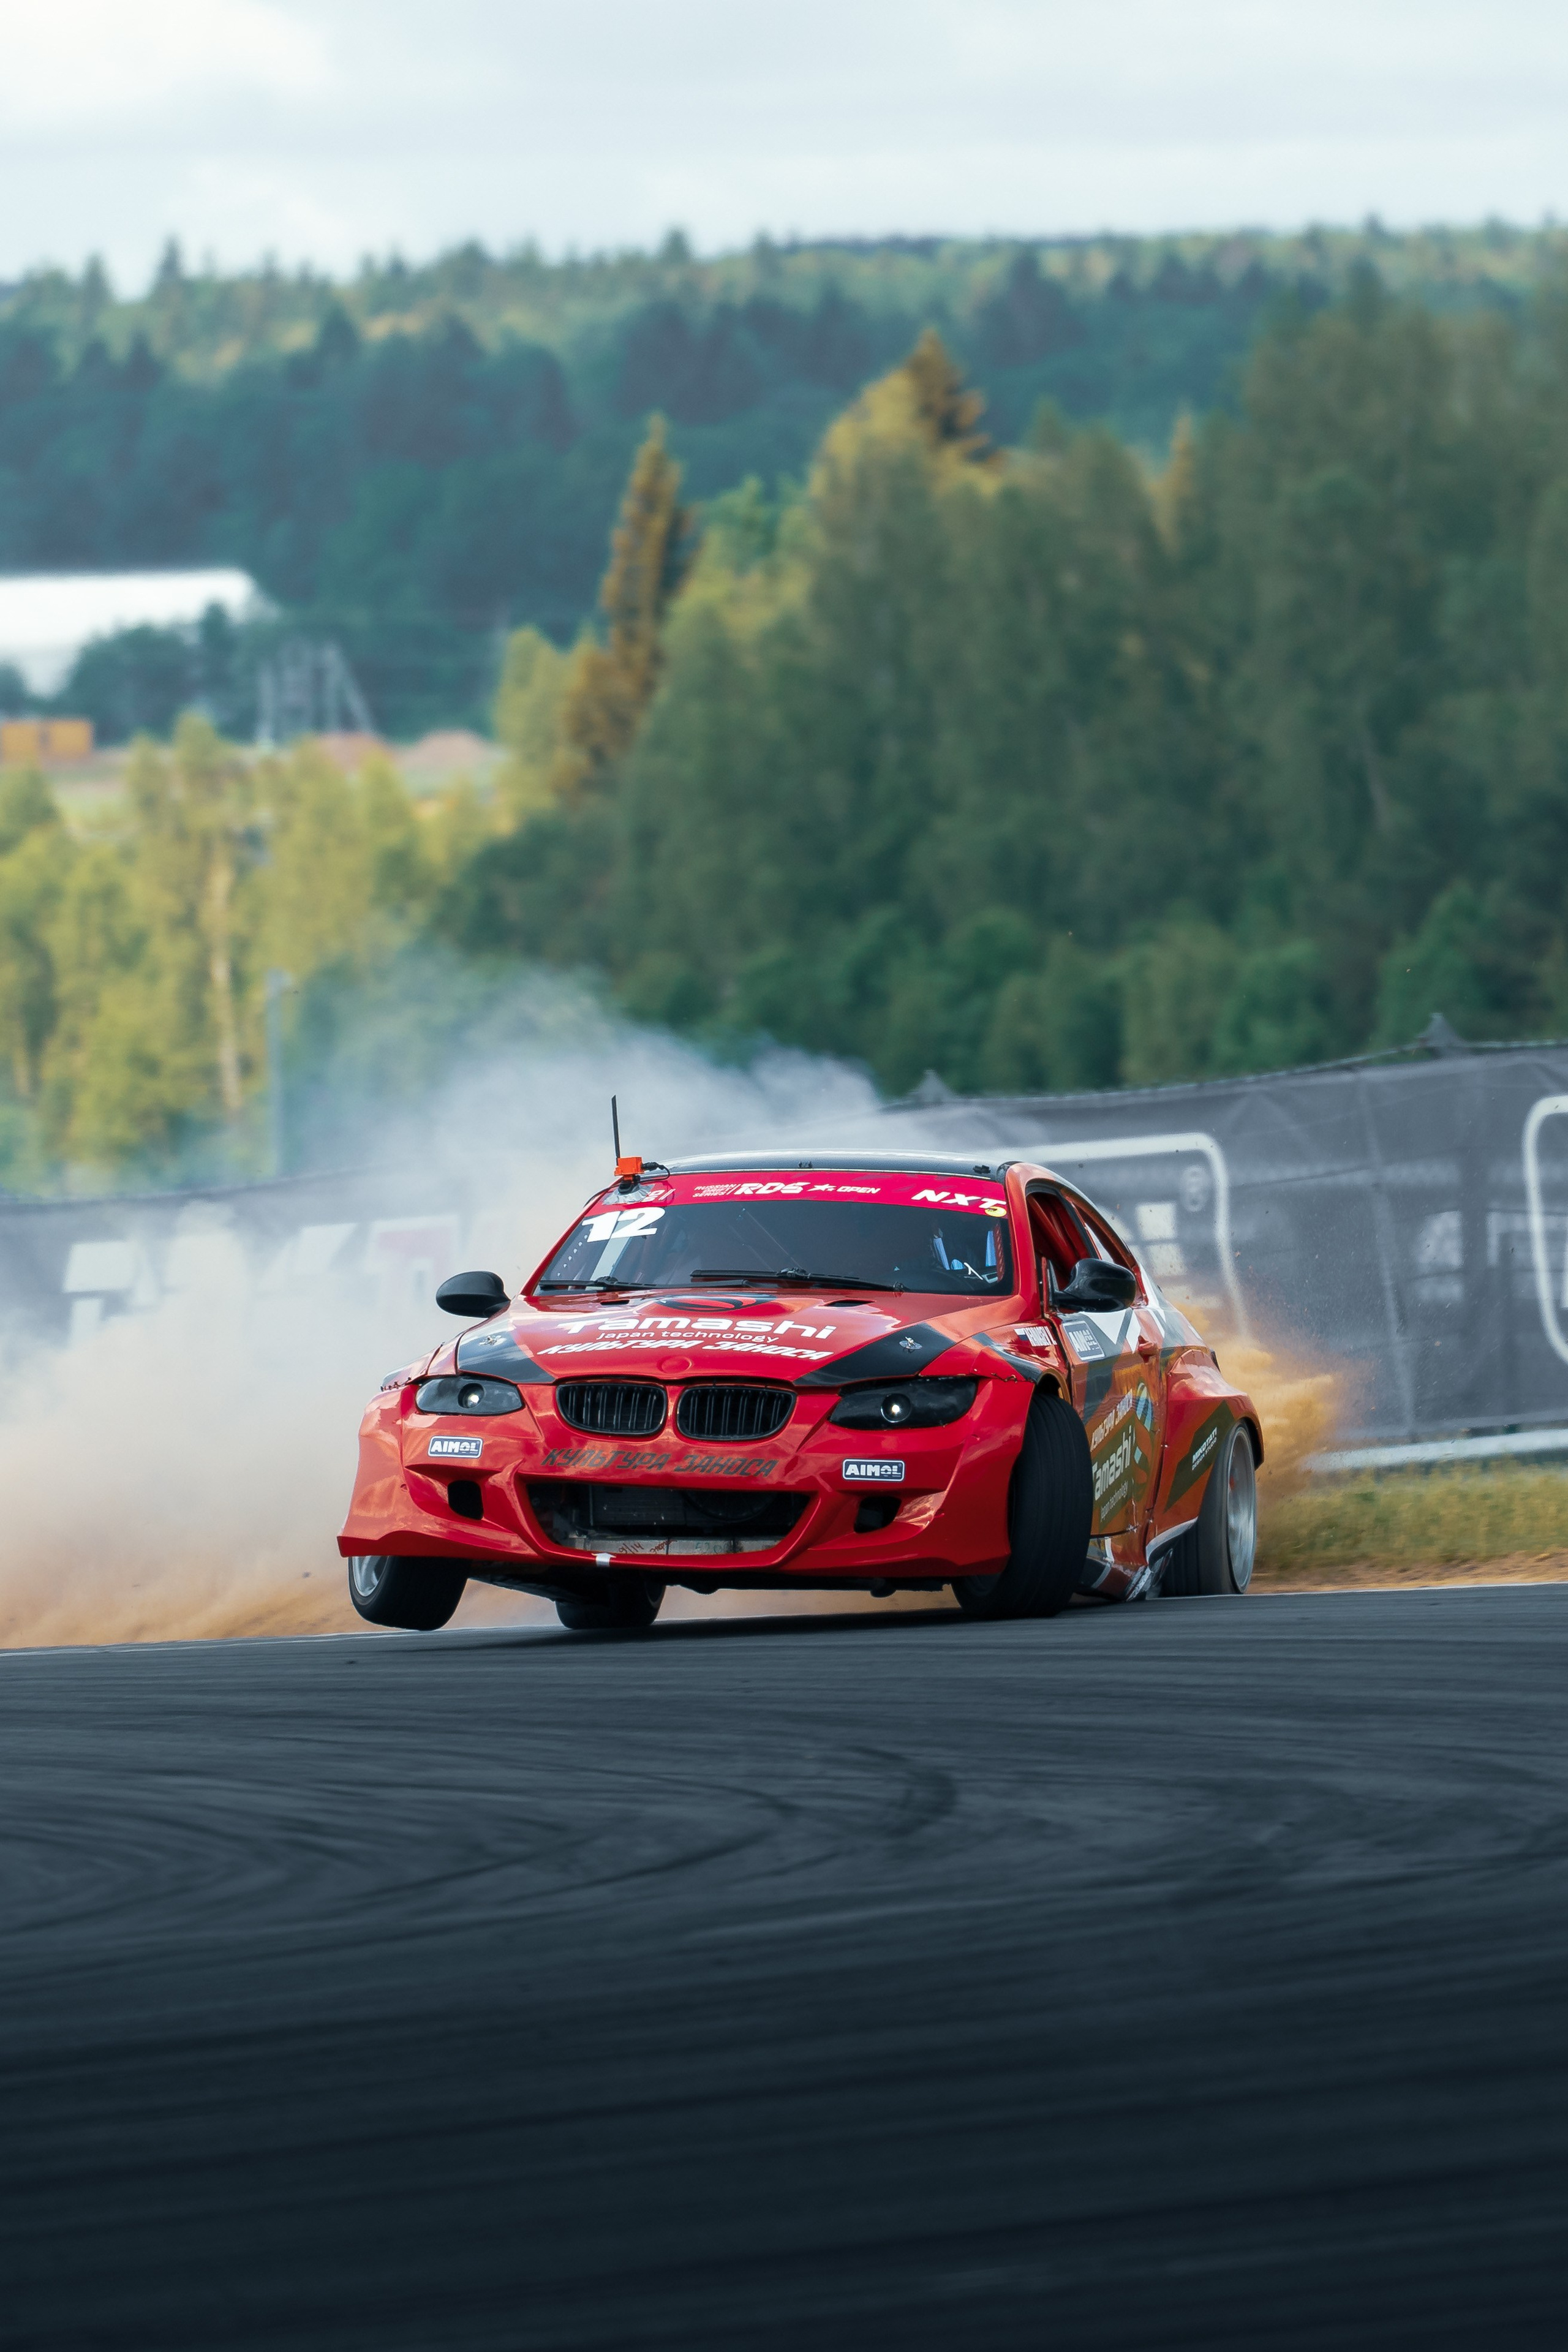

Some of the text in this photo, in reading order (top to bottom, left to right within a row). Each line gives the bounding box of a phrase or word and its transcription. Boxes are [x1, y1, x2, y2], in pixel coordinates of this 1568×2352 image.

[734, 1182, 881, 1195] RDS OPEN
[911, 1189, 1007, 1210] NXT
[581, 1207, 666, 1243] 12
[556, 1316, 837, 1340] Tamashi
[596, 1330, 780, 1343] japan technology
[537, 1340, 834, 1360] КУЛЬТУРА ЗАНОСА
[431, 1441, 478, 1454] AIMOL
[540, 1448, 780, 1477] КУЛЬТУРА ЗАНОСА
[845, 1464, 902, 1477] AIMOL
[1092, 1425, 1132, 1501] Tamashi
